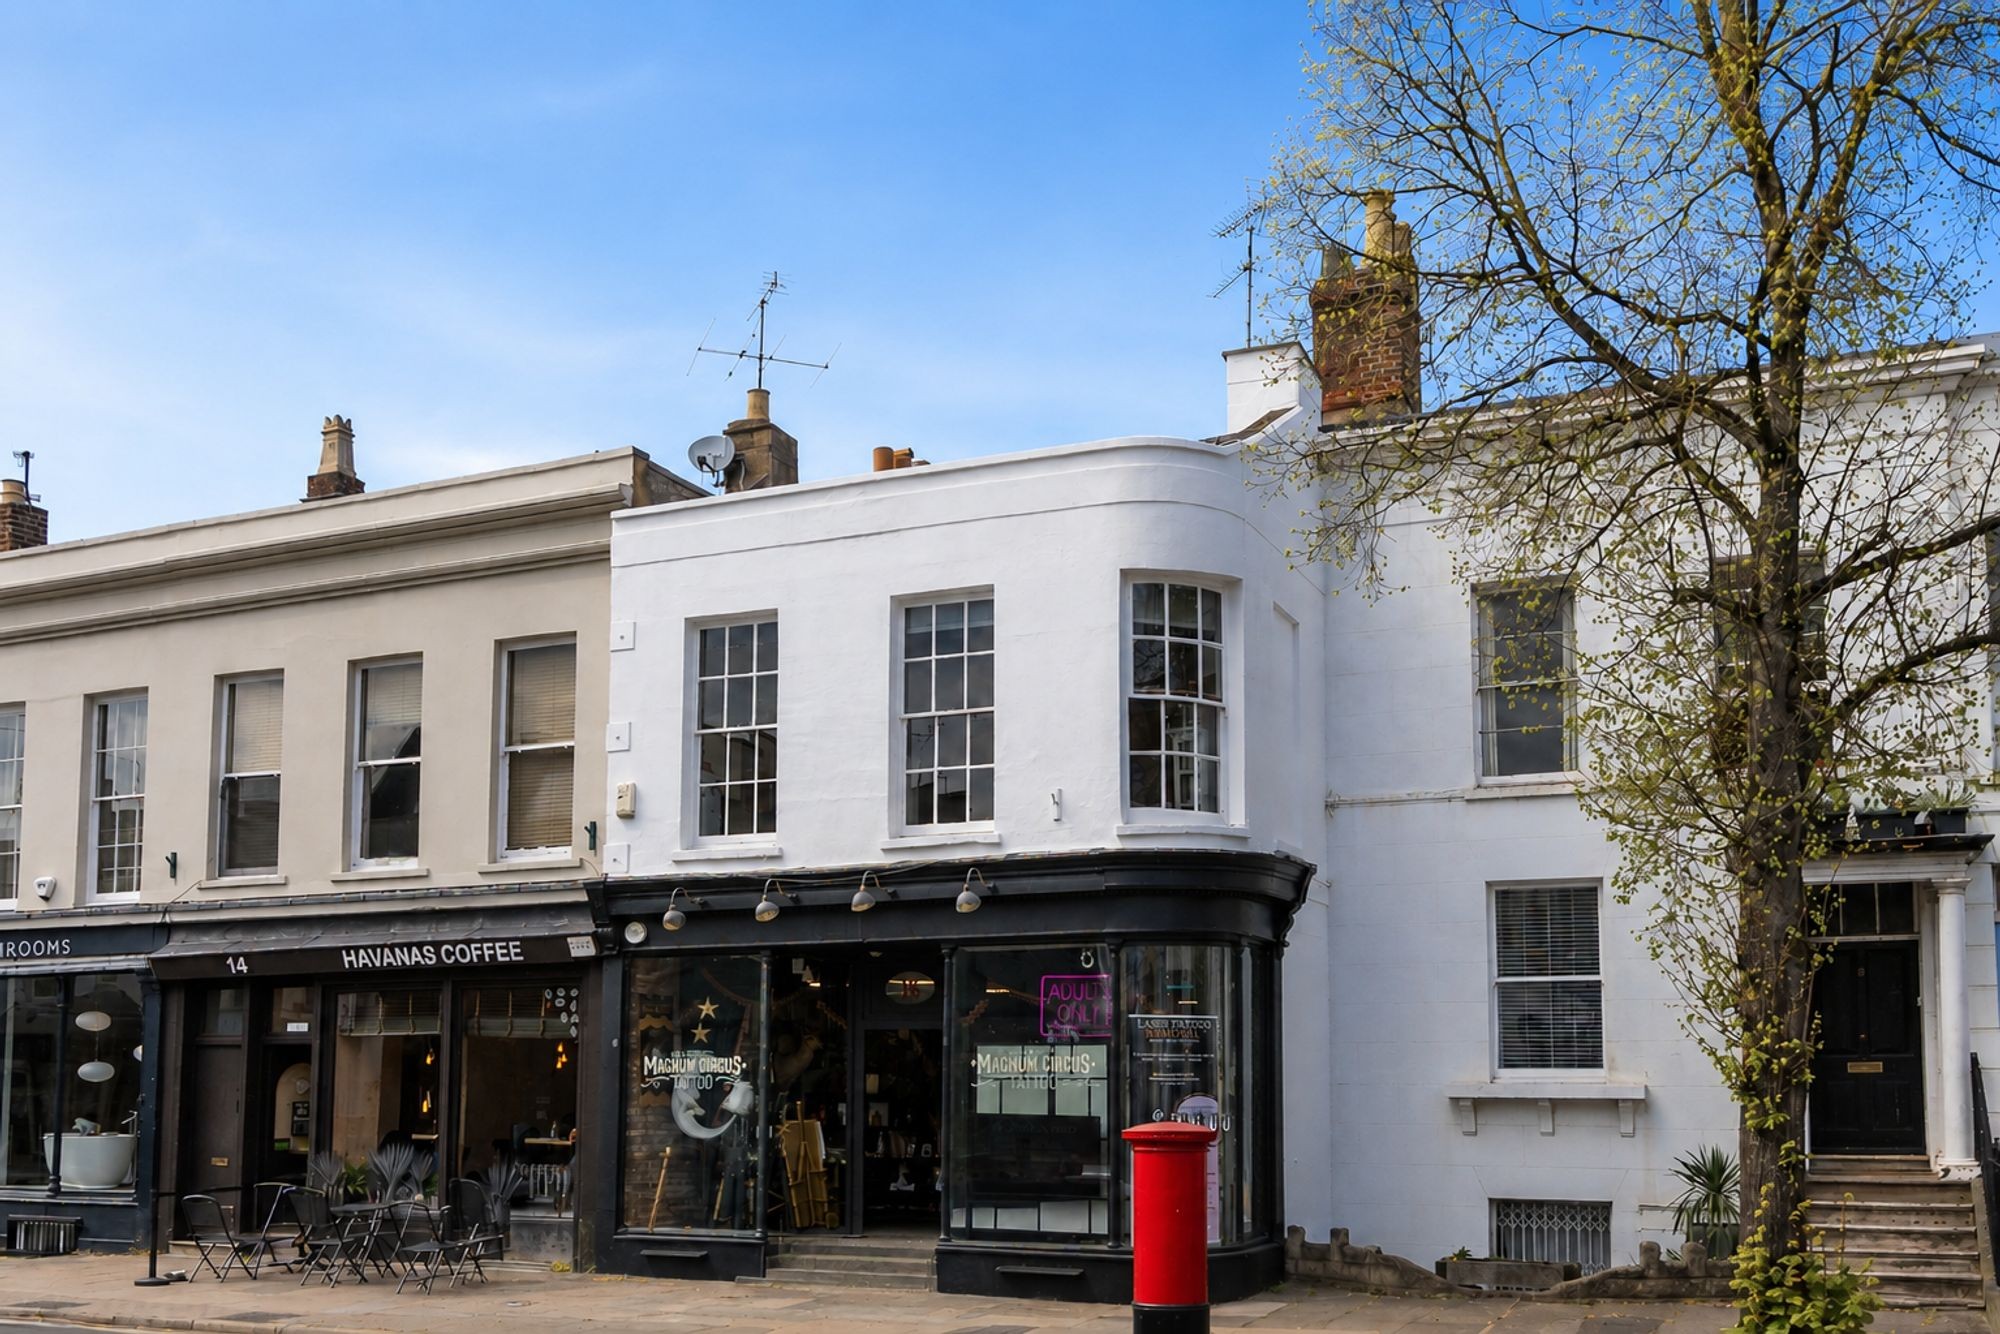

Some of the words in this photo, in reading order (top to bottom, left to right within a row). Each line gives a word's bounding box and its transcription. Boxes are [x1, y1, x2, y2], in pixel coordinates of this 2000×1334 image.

[226, 956, 248, 974] 14
[342, 945, 437, 968] HAVANAS
[441, 941, 524, 964] COFFEE
[1042, 1053, 1090, 1074] CIRCUS
